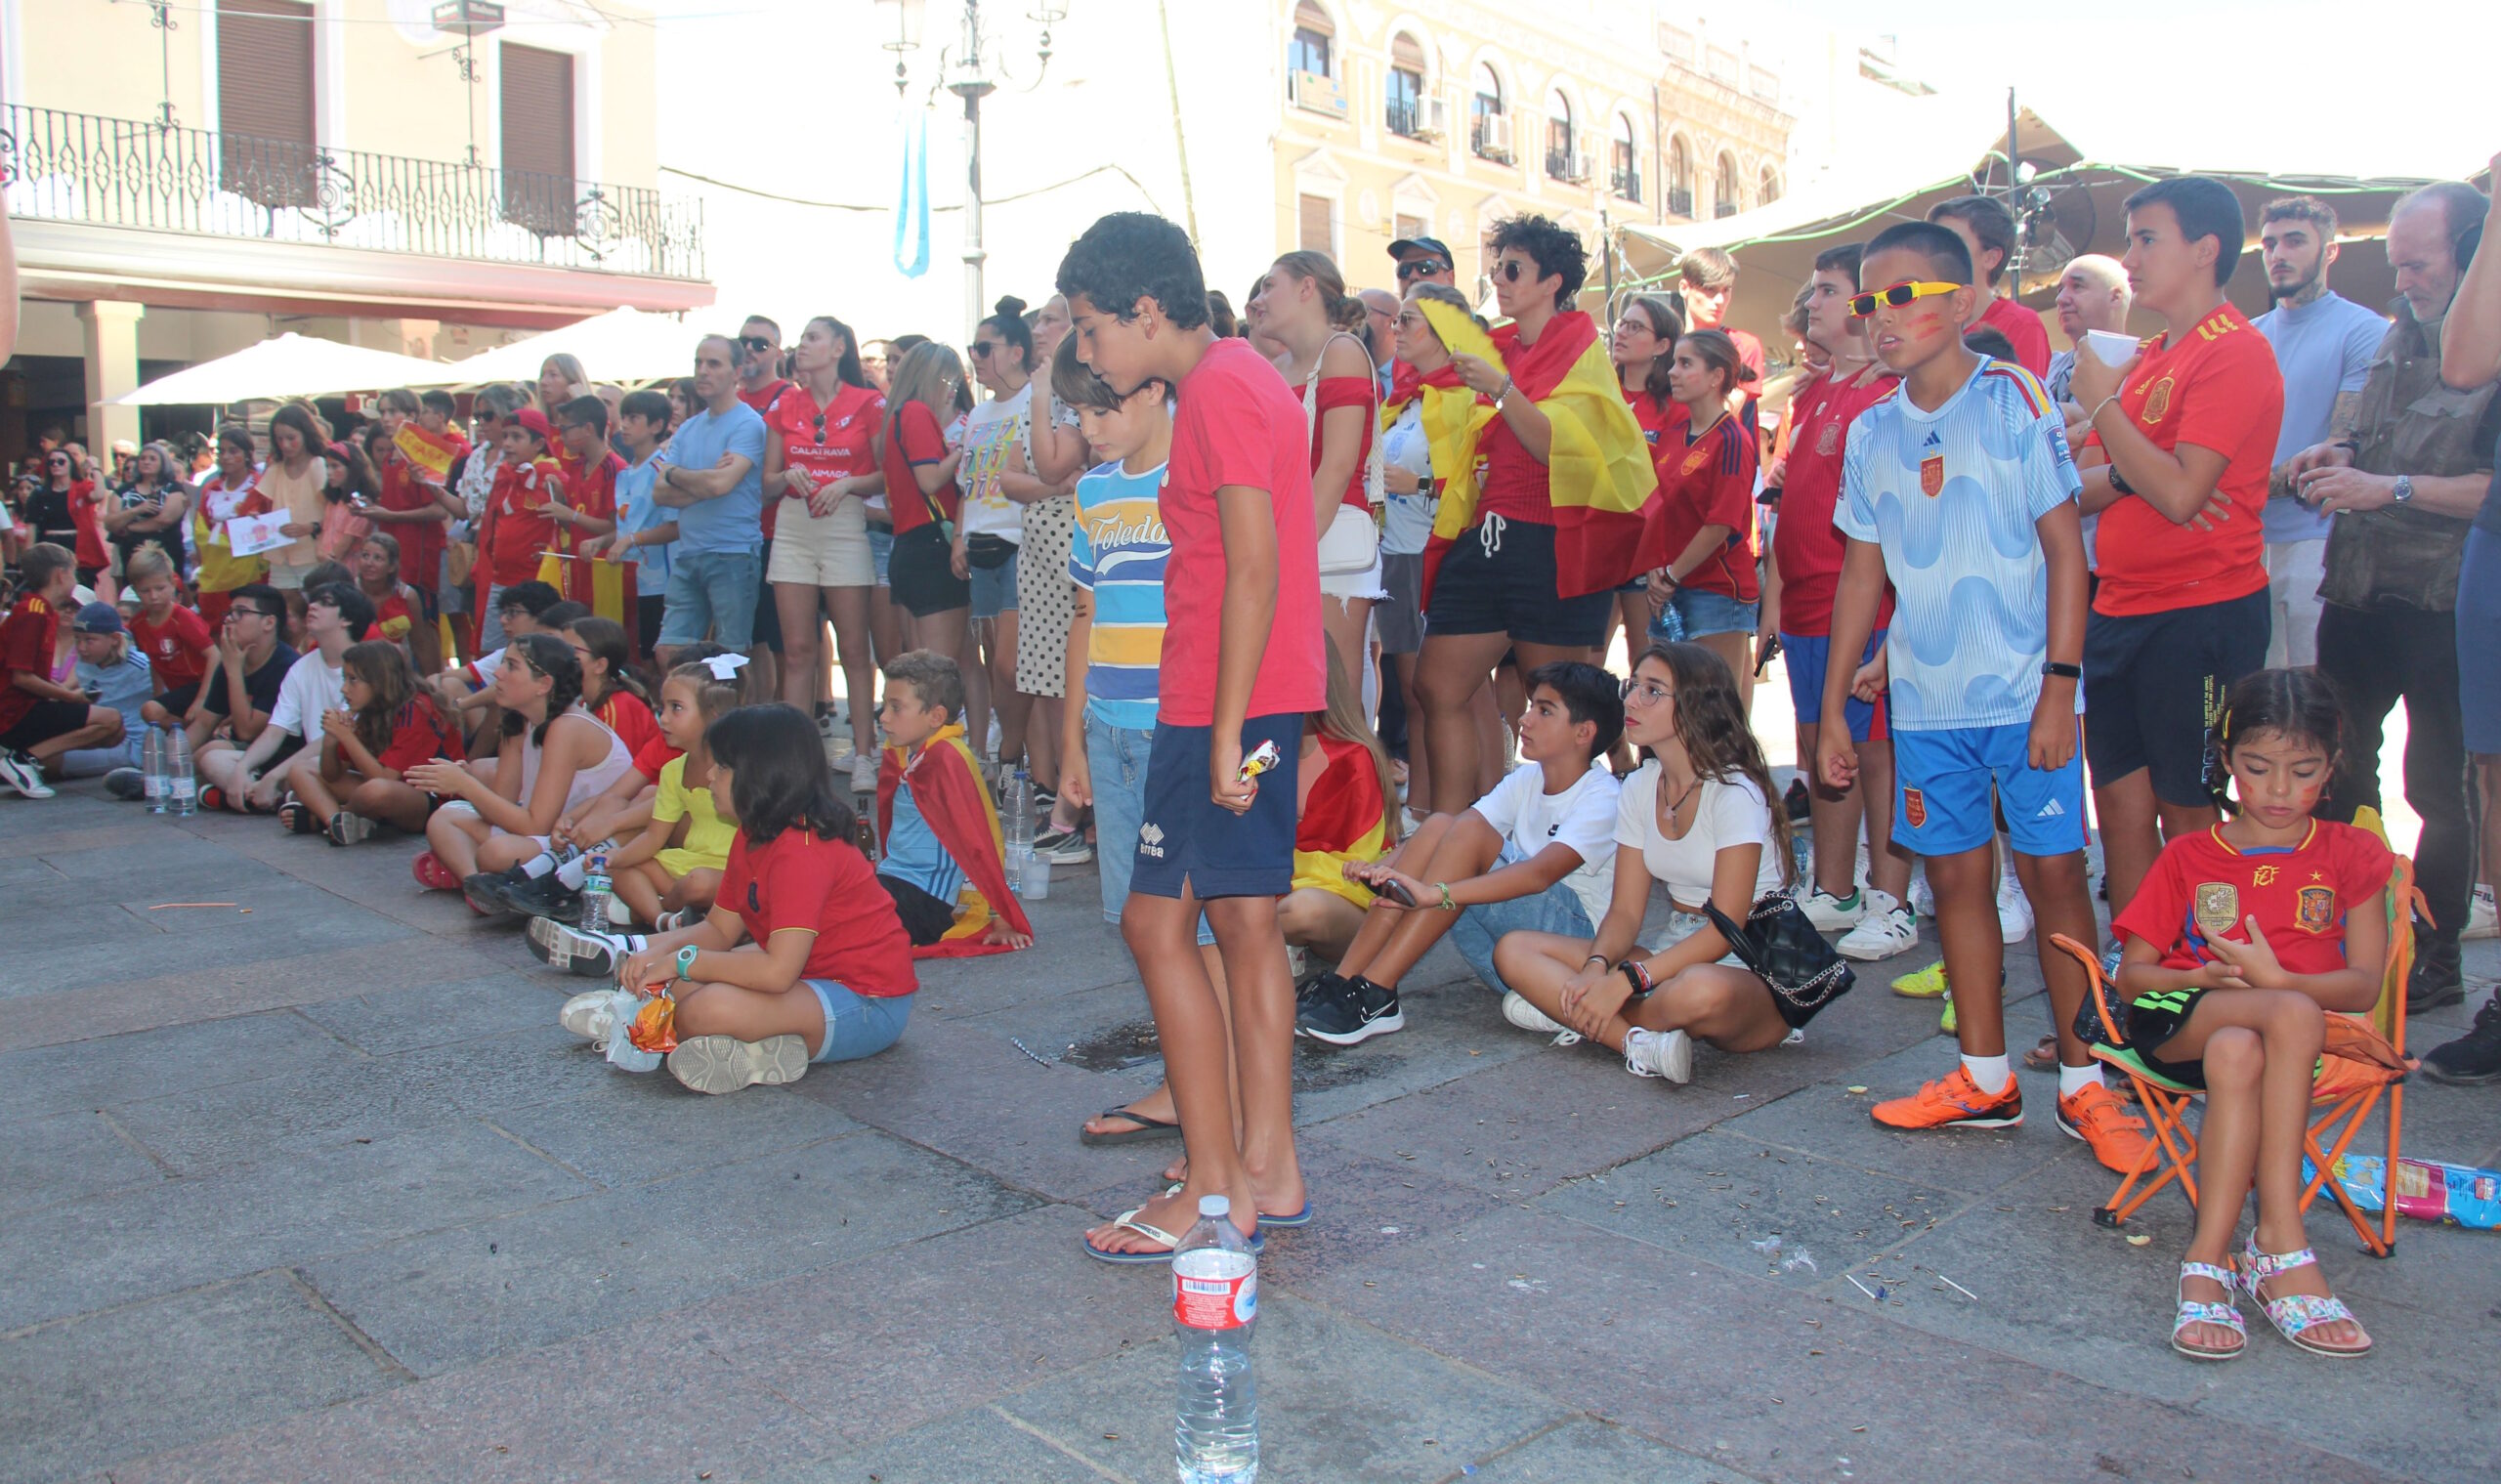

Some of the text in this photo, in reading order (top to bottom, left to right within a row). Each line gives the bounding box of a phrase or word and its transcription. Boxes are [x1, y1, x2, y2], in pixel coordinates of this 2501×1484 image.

[789, 445, 851, 456] CALATRAVA
[1089, 509, 1167, 564] Toledo
[2474, 890, 2494, 903] FIL
